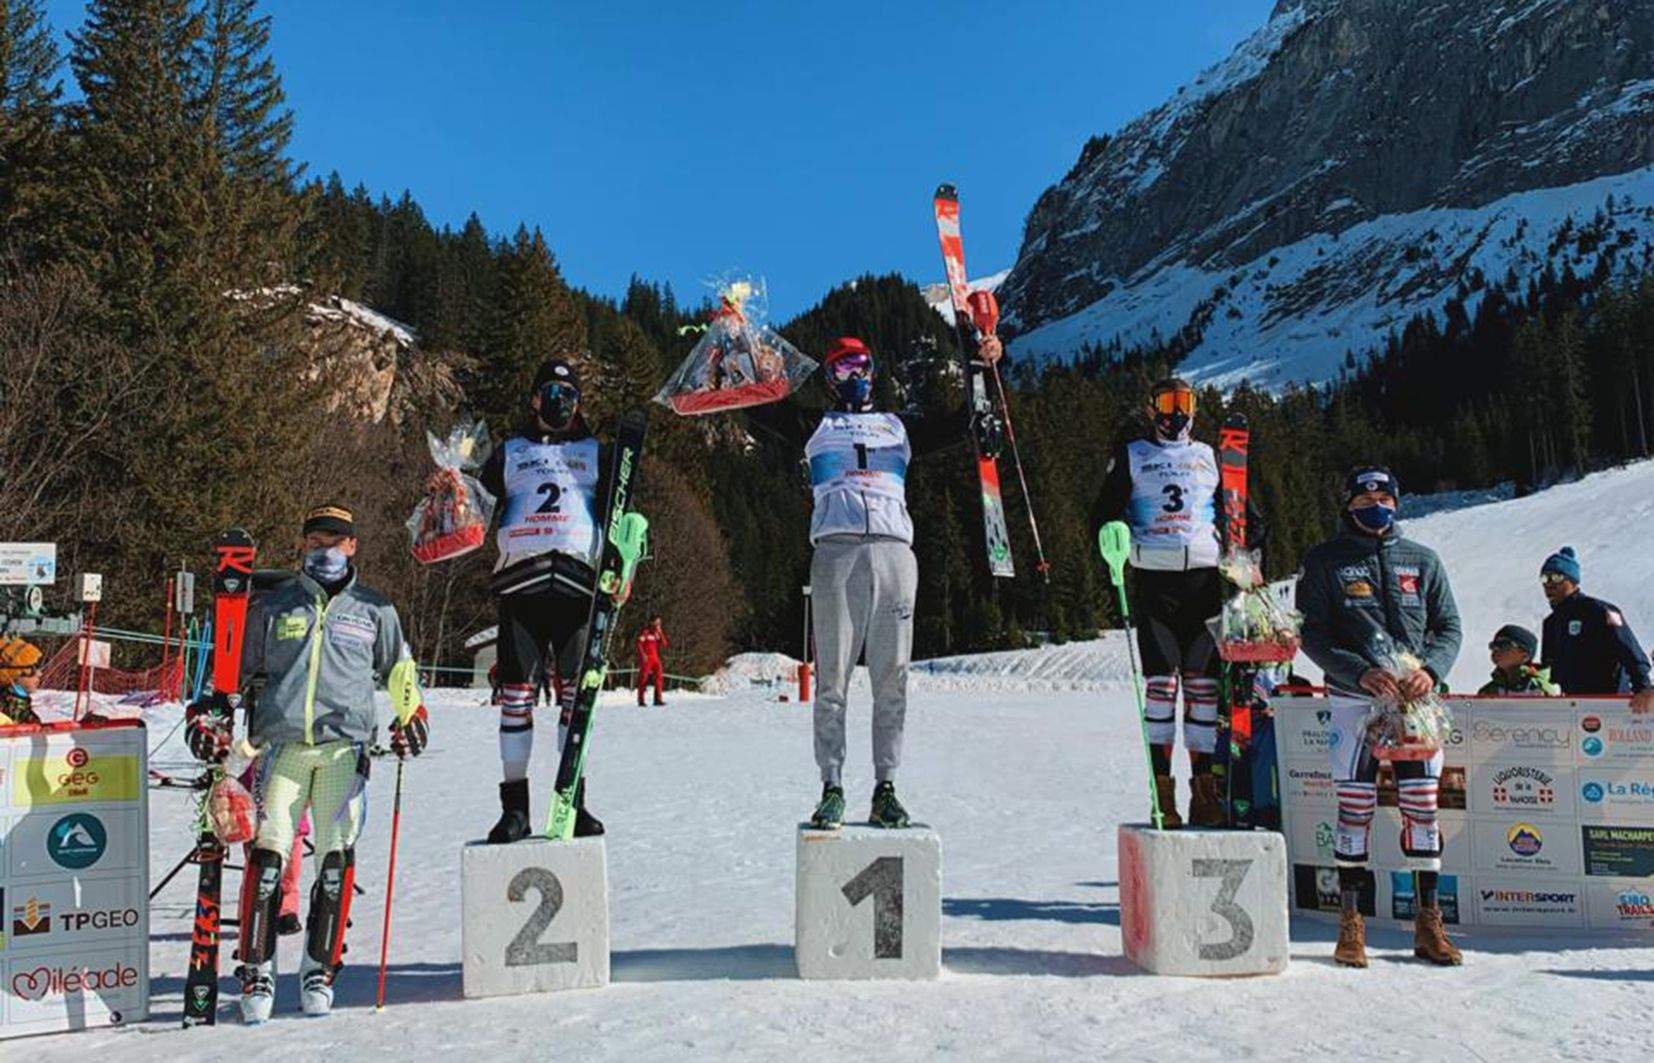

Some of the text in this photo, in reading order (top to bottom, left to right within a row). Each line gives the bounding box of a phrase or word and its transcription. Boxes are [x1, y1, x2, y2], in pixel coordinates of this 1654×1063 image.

[608, 447, 634, 546] FISCHER
[1607, 783, 1626, 795] La
[60, 909, 139, 931] TPGEO
[505, 867, 578, 966] 2
[841, 856, 903, 959] 1
[1192, 859, 1254, 961] 3
[1495, 892, 1575, 903] INTERSPORT
[13, 962, 138, 1001] Miléade
